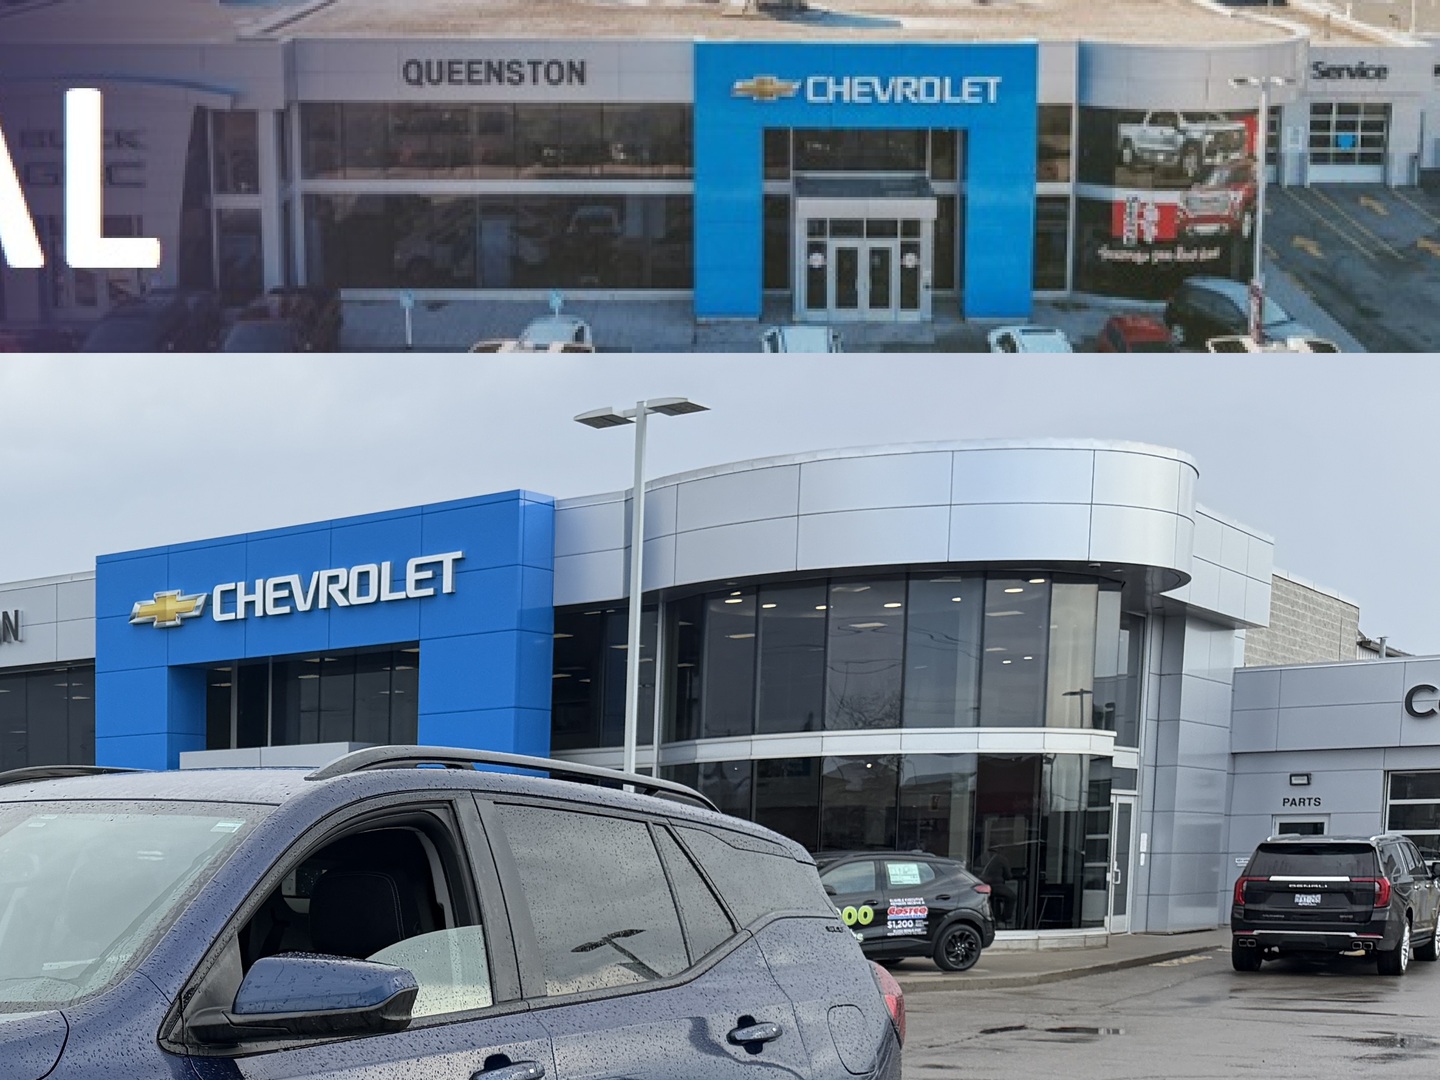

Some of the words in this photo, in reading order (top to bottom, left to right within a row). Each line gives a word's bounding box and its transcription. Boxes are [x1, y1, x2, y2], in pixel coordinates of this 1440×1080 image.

[212, 550, 464, 622] CHEVROLET
[1282, 797, 1321, 807] PARTS
[887, 920, 914, 929] $1,200
